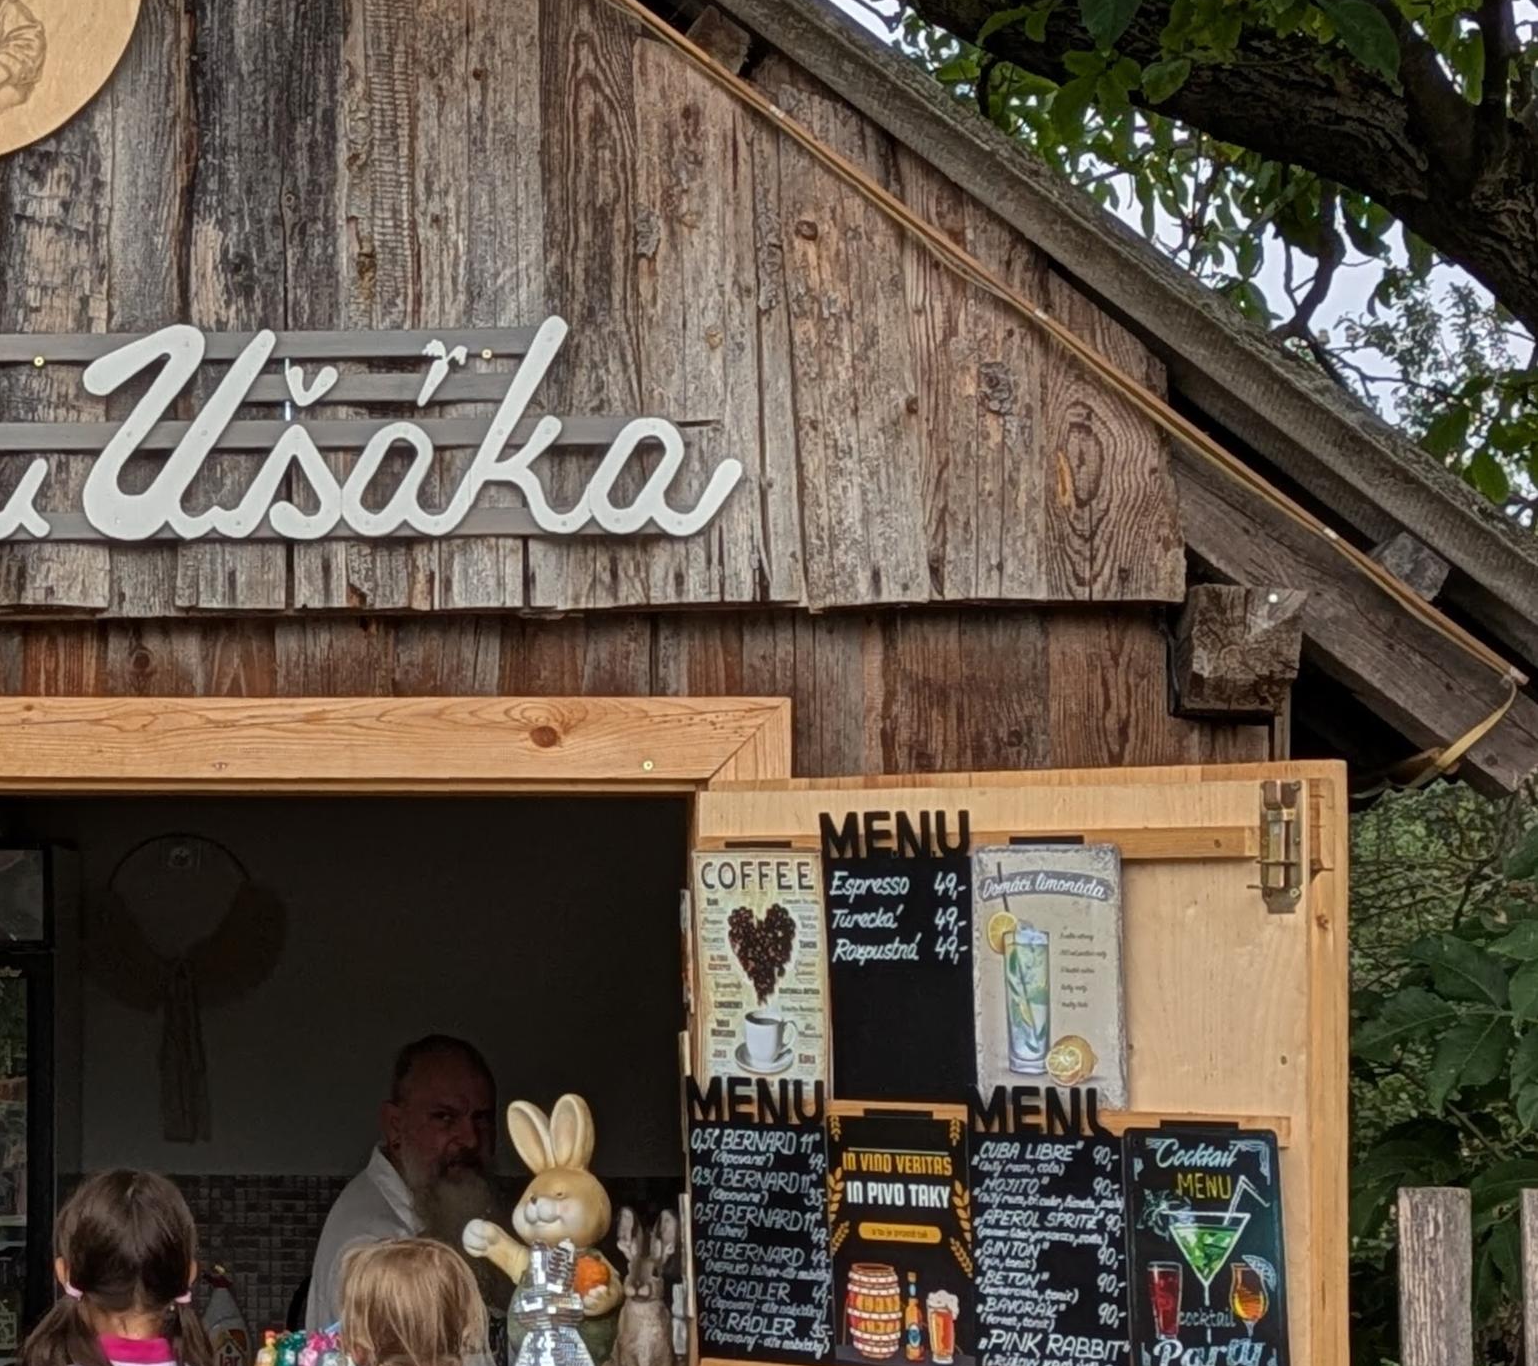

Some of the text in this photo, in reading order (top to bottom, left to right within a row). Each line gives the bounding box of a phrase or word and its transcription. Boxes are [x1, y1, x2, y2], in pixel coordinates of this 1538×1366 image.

[83, 315, 744, 540] Ušáka
[819, 810, 970, 857] MENU
[701, 861, 814, 890] COFFEE
[829, 871, 967, 904] Espresso 49,-
[1036, 872, 1106, 899] limonáda
[831, 903, 904, 930] Turecká
[934, 906, 967, 936] 49,-
[832, 932, 969, 966] Rozpustná 49,-
[684, 1076, 824, 1124] MENU
[720, 1129, 797, 1155] BERNARD
[1155, 1138, 1239, 1168] Cocktail
[843, 1151, 953, 1176] IN VINO VERITAS
[1093, 1146, 1119, 1171] 90,-
[721, 1168, 799, 1194] BERNARD
[1176, 1172, 1232, 1200] MENU
[846, 1181, 951, 1209] IN PIVO TAKY
[721, 1204, 803, 1232] BERNARD
[722, 1242, 805, 1267] BERNARD
[723, 1278, 791, 1303] RADLER
[1097, 1273, 1126, 1297] 90,-
[726, 1312, 796, 1338] RADLER
[1098, 1303, 1127, 1328] 90,-
[1179, 1308, 1236, 1327] cocktail
